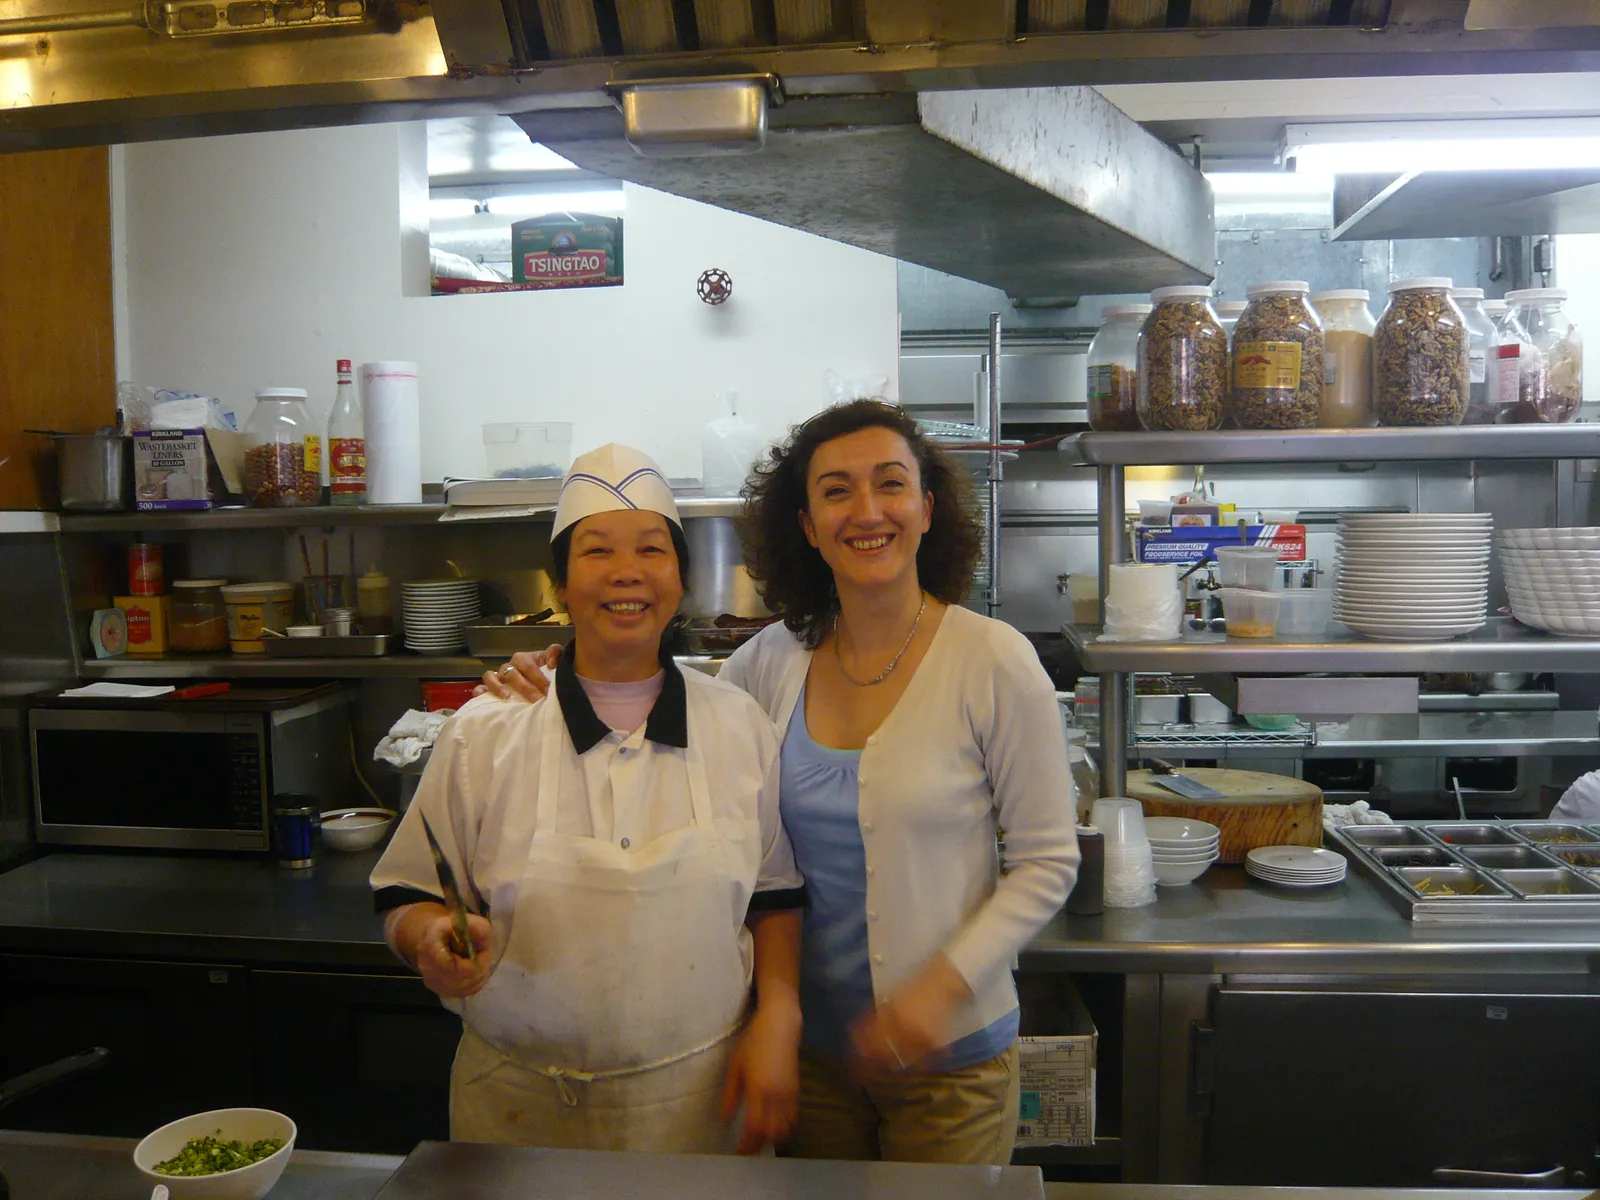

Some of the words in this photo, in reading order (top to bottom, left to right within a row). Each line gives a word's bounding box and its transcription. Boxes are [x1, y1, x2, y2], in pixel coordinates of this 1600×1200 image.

[529, 256, 600, 273] TSINGTAO
[138, 441, 198, 452] WASTEBASKET
[153, 451, 184, 460] LINERS
[138, 502, 153, 510] 500
[127, 614, 150, 622] ipton
